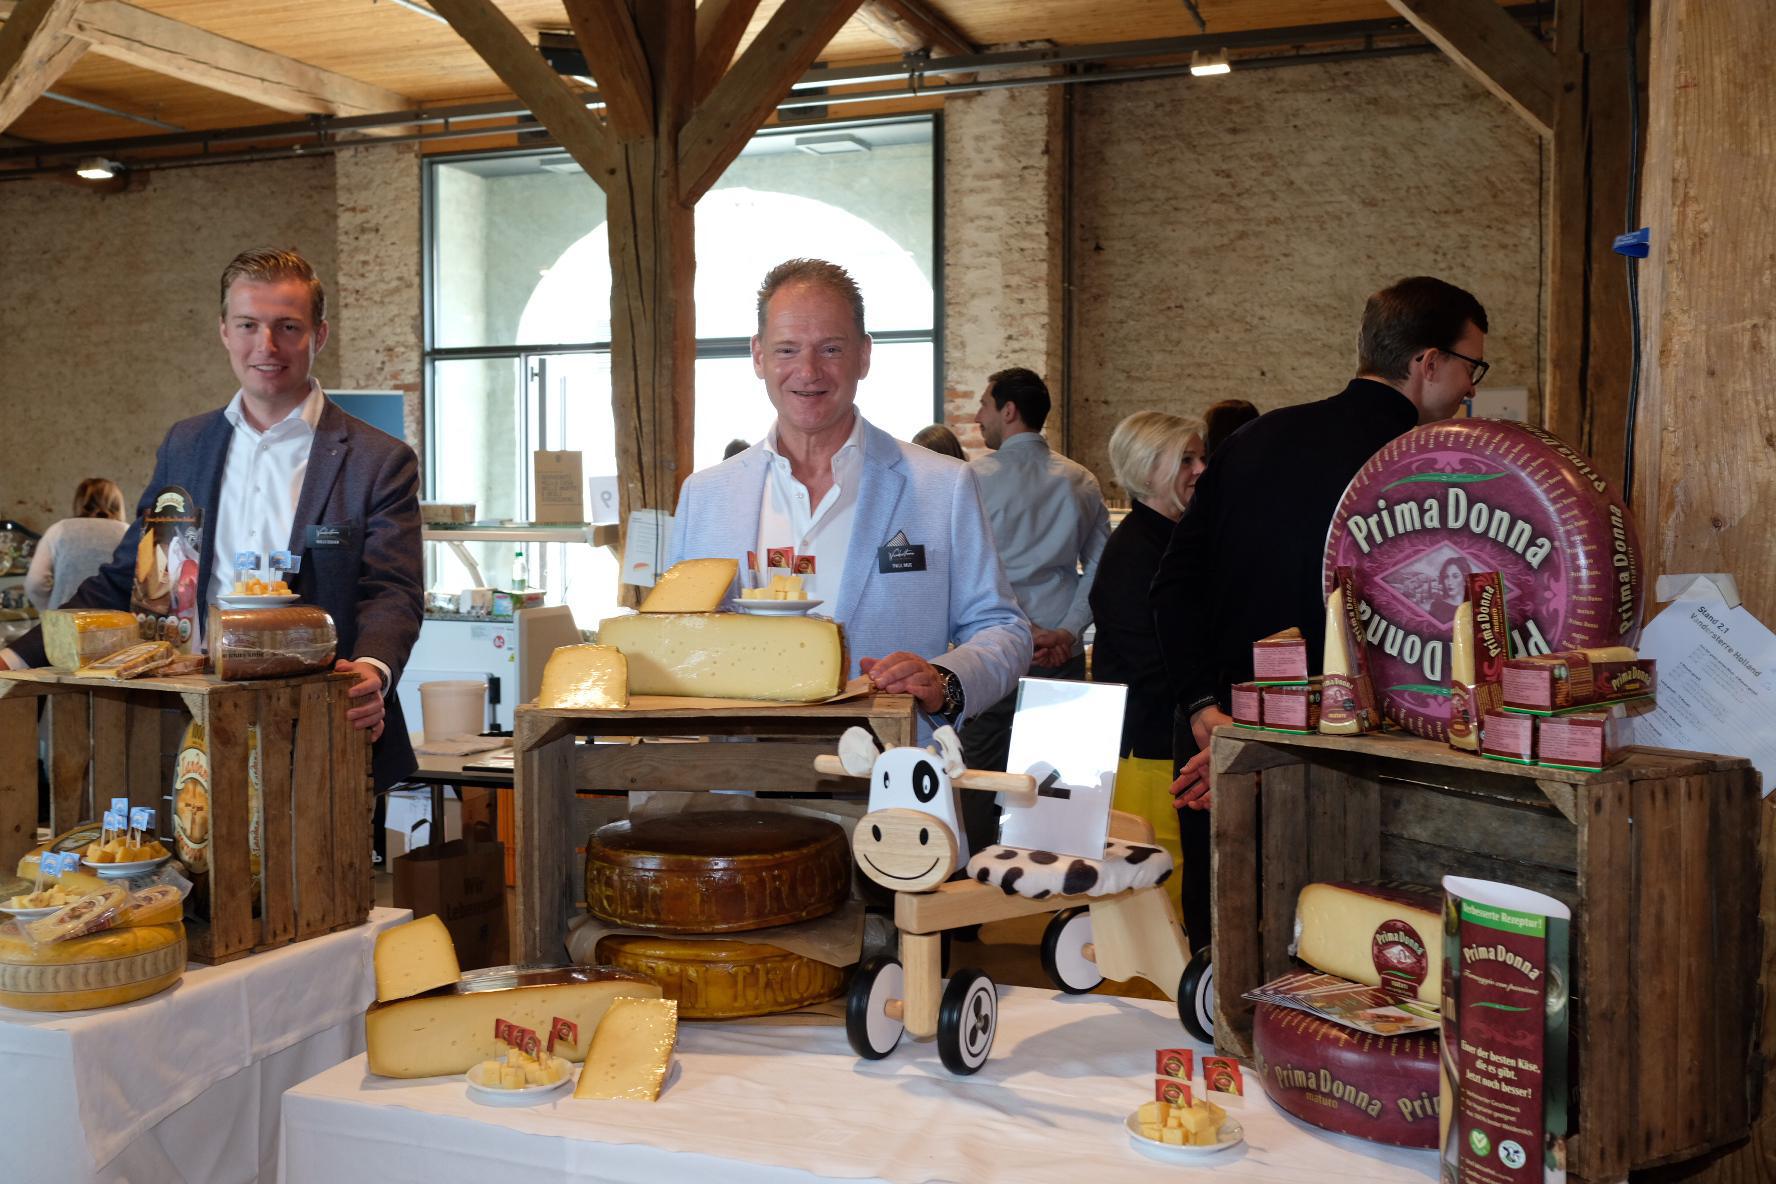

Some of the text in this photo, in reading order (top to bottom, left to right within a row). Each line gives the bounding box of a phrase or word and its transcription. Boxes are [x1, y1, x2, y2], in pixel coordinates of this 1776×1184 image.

[1347, 499, 1441, 554] Prima
[1447, 487, 1552, 570] Donna
[1609, 504, 1635, 635] Prima Donna
[1477, 585, 1495, 622] Donna
[1697, 606, 1730, 635] Stand 2.1
[1480, 623, 1502, 658] Prima
[1690, 613, 1734, 654] Vandersterre
[1732, 650, 1762, 678] Holland
[1501, 912, 1542, 929] Rezeptur!
[1376, 930, 1425, 955] Prima Donna
[1463, 944, 1541, 981] Prima Donna
[1461, 1040, 1476, 1054] Einer
[1477, 1048, 1489, 1059] der
[1490, 1051, 1516, 1067] besten
[1475, 1059, 1487, 1071] die
[1488, 1065, 1496, 1074] es
[1275, 1064, 1383, 1119] Prima Donna
[1306, 1091, 1339, 1109] maturo
[1482, 1077, 1500, 1090] noch
[1501, 1082, 1532, 1099] besser!
[1397, 1091, 1440, 1123] Pri
